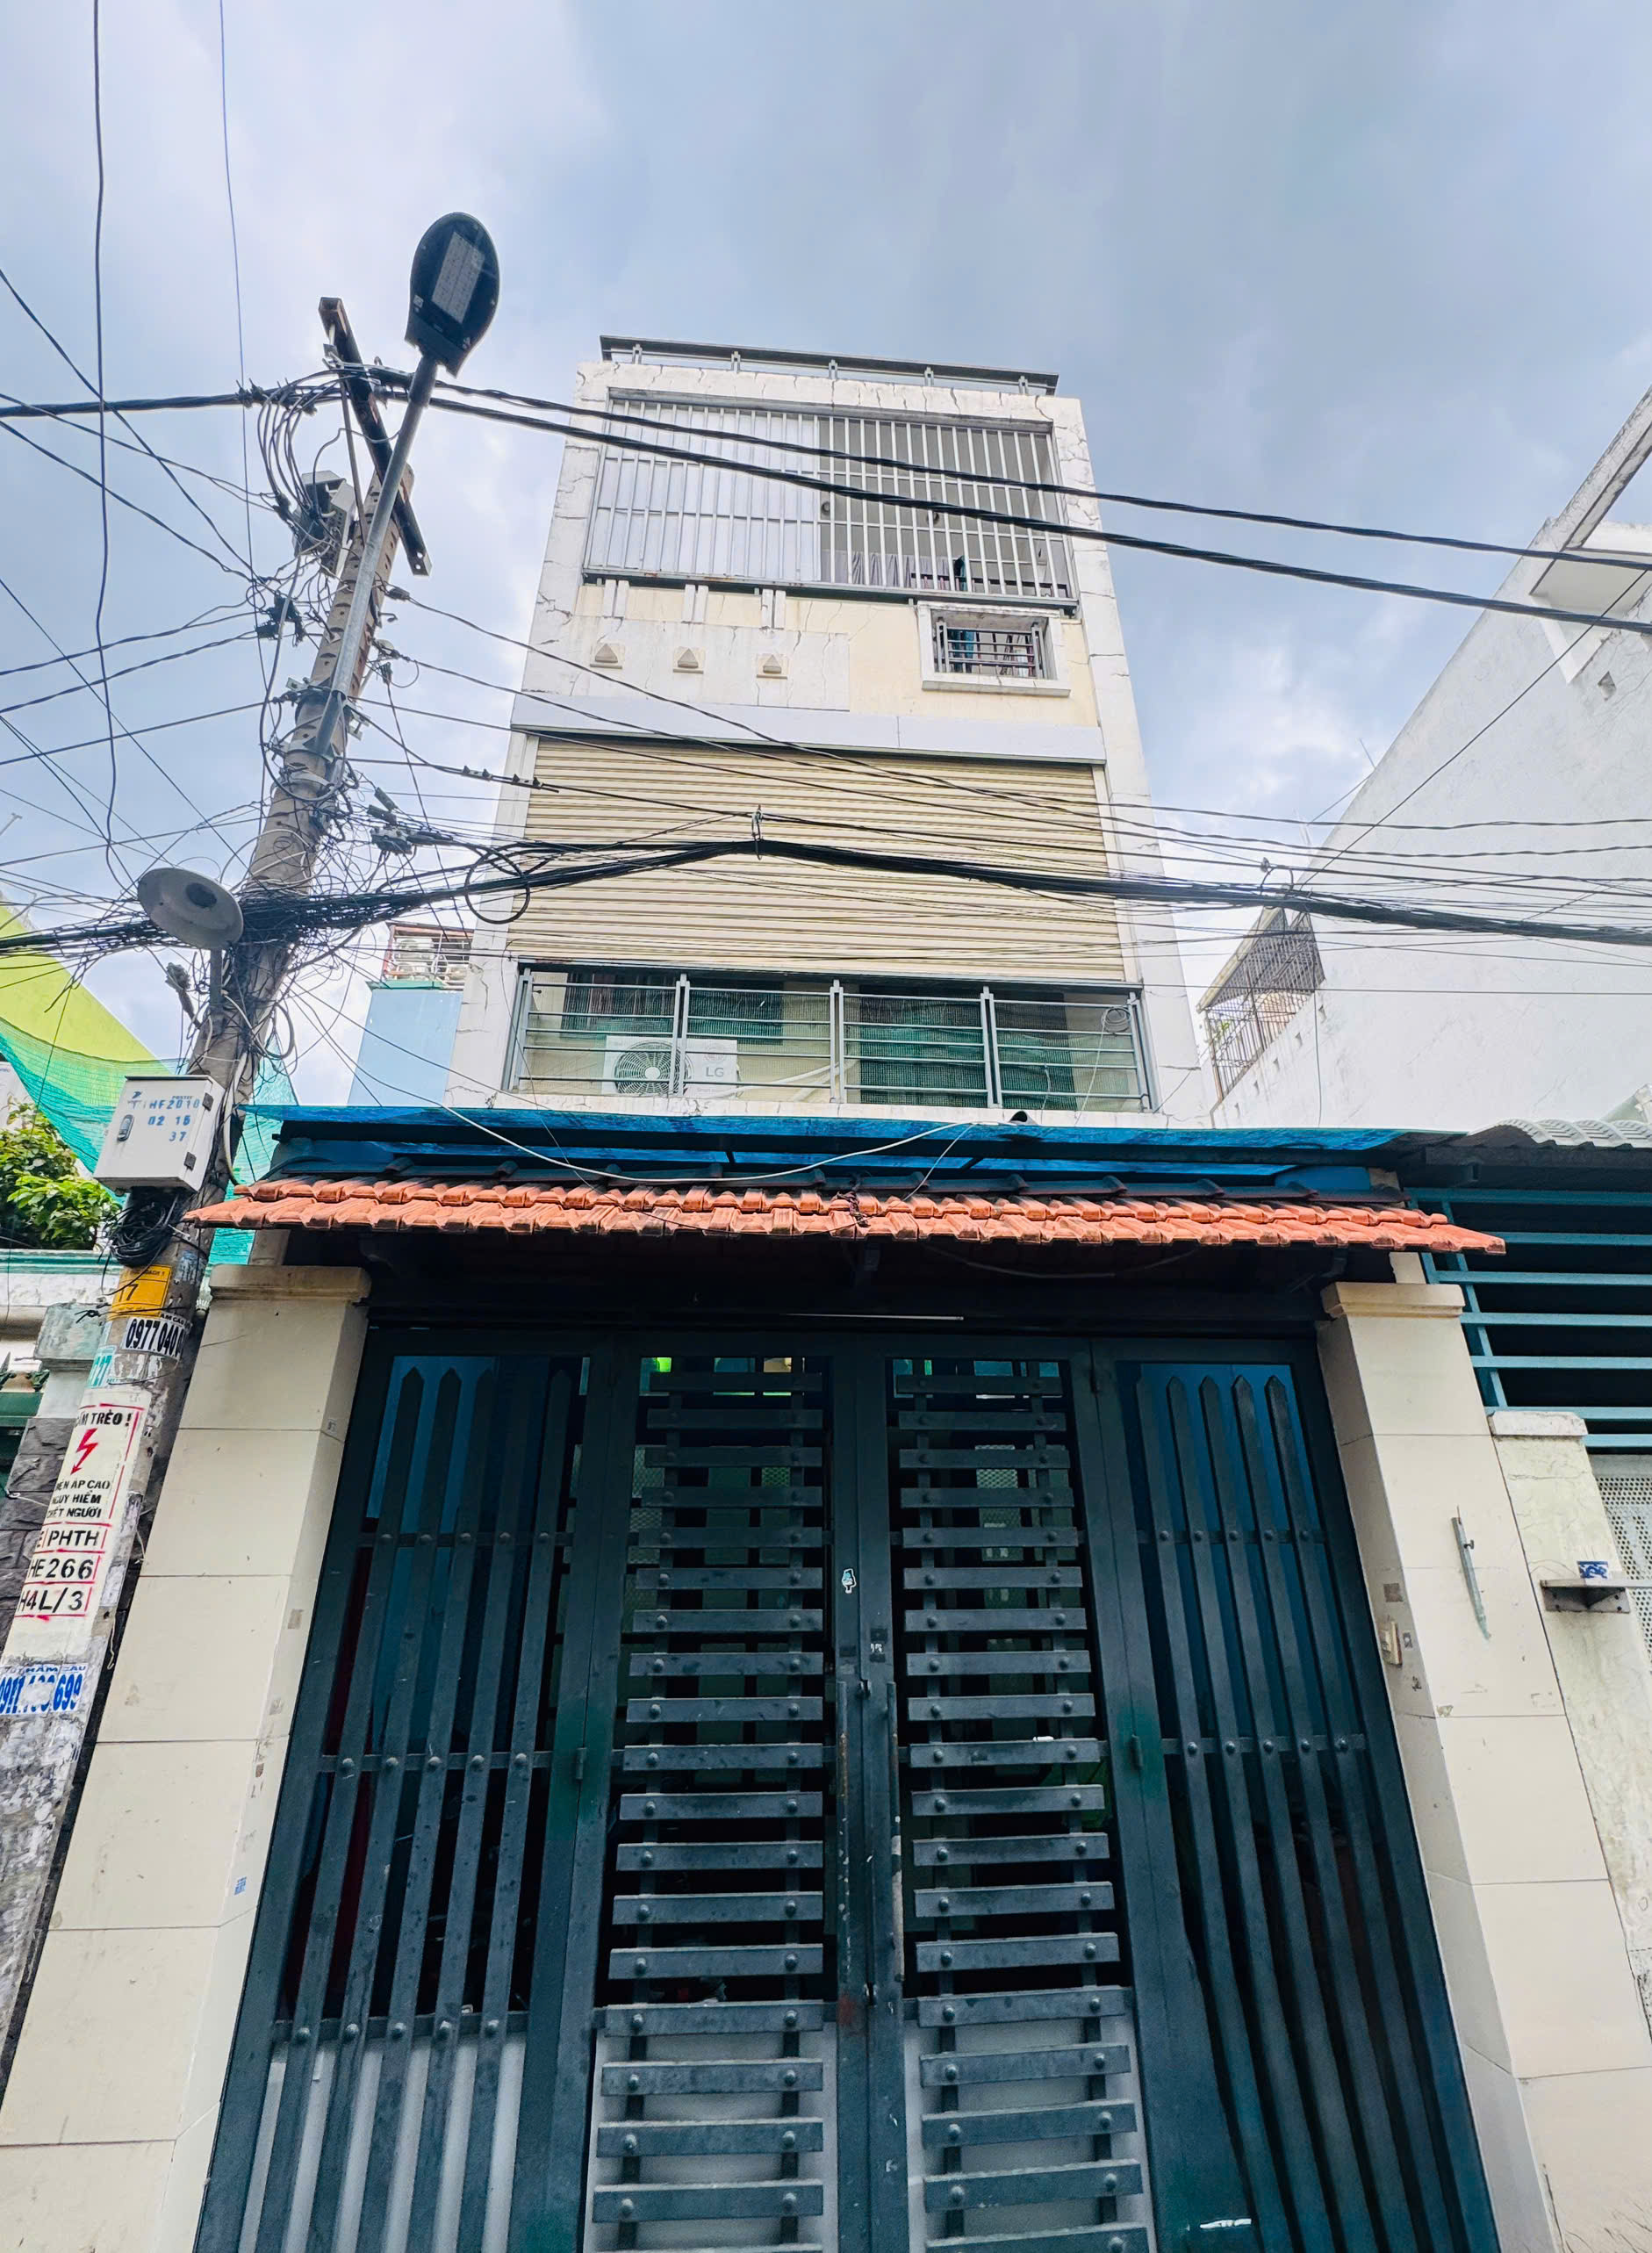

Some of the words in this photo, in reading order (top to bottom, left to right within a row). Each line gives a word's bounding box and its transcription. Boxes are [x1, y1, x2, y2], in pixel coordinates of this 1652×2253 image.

[706, 1067, 724, 1077] LG
[169, 1131, 187, 1142] 37
[86, 1479, 111, 1489] CAO
[47, 1530, 100, 1546] PHTH
